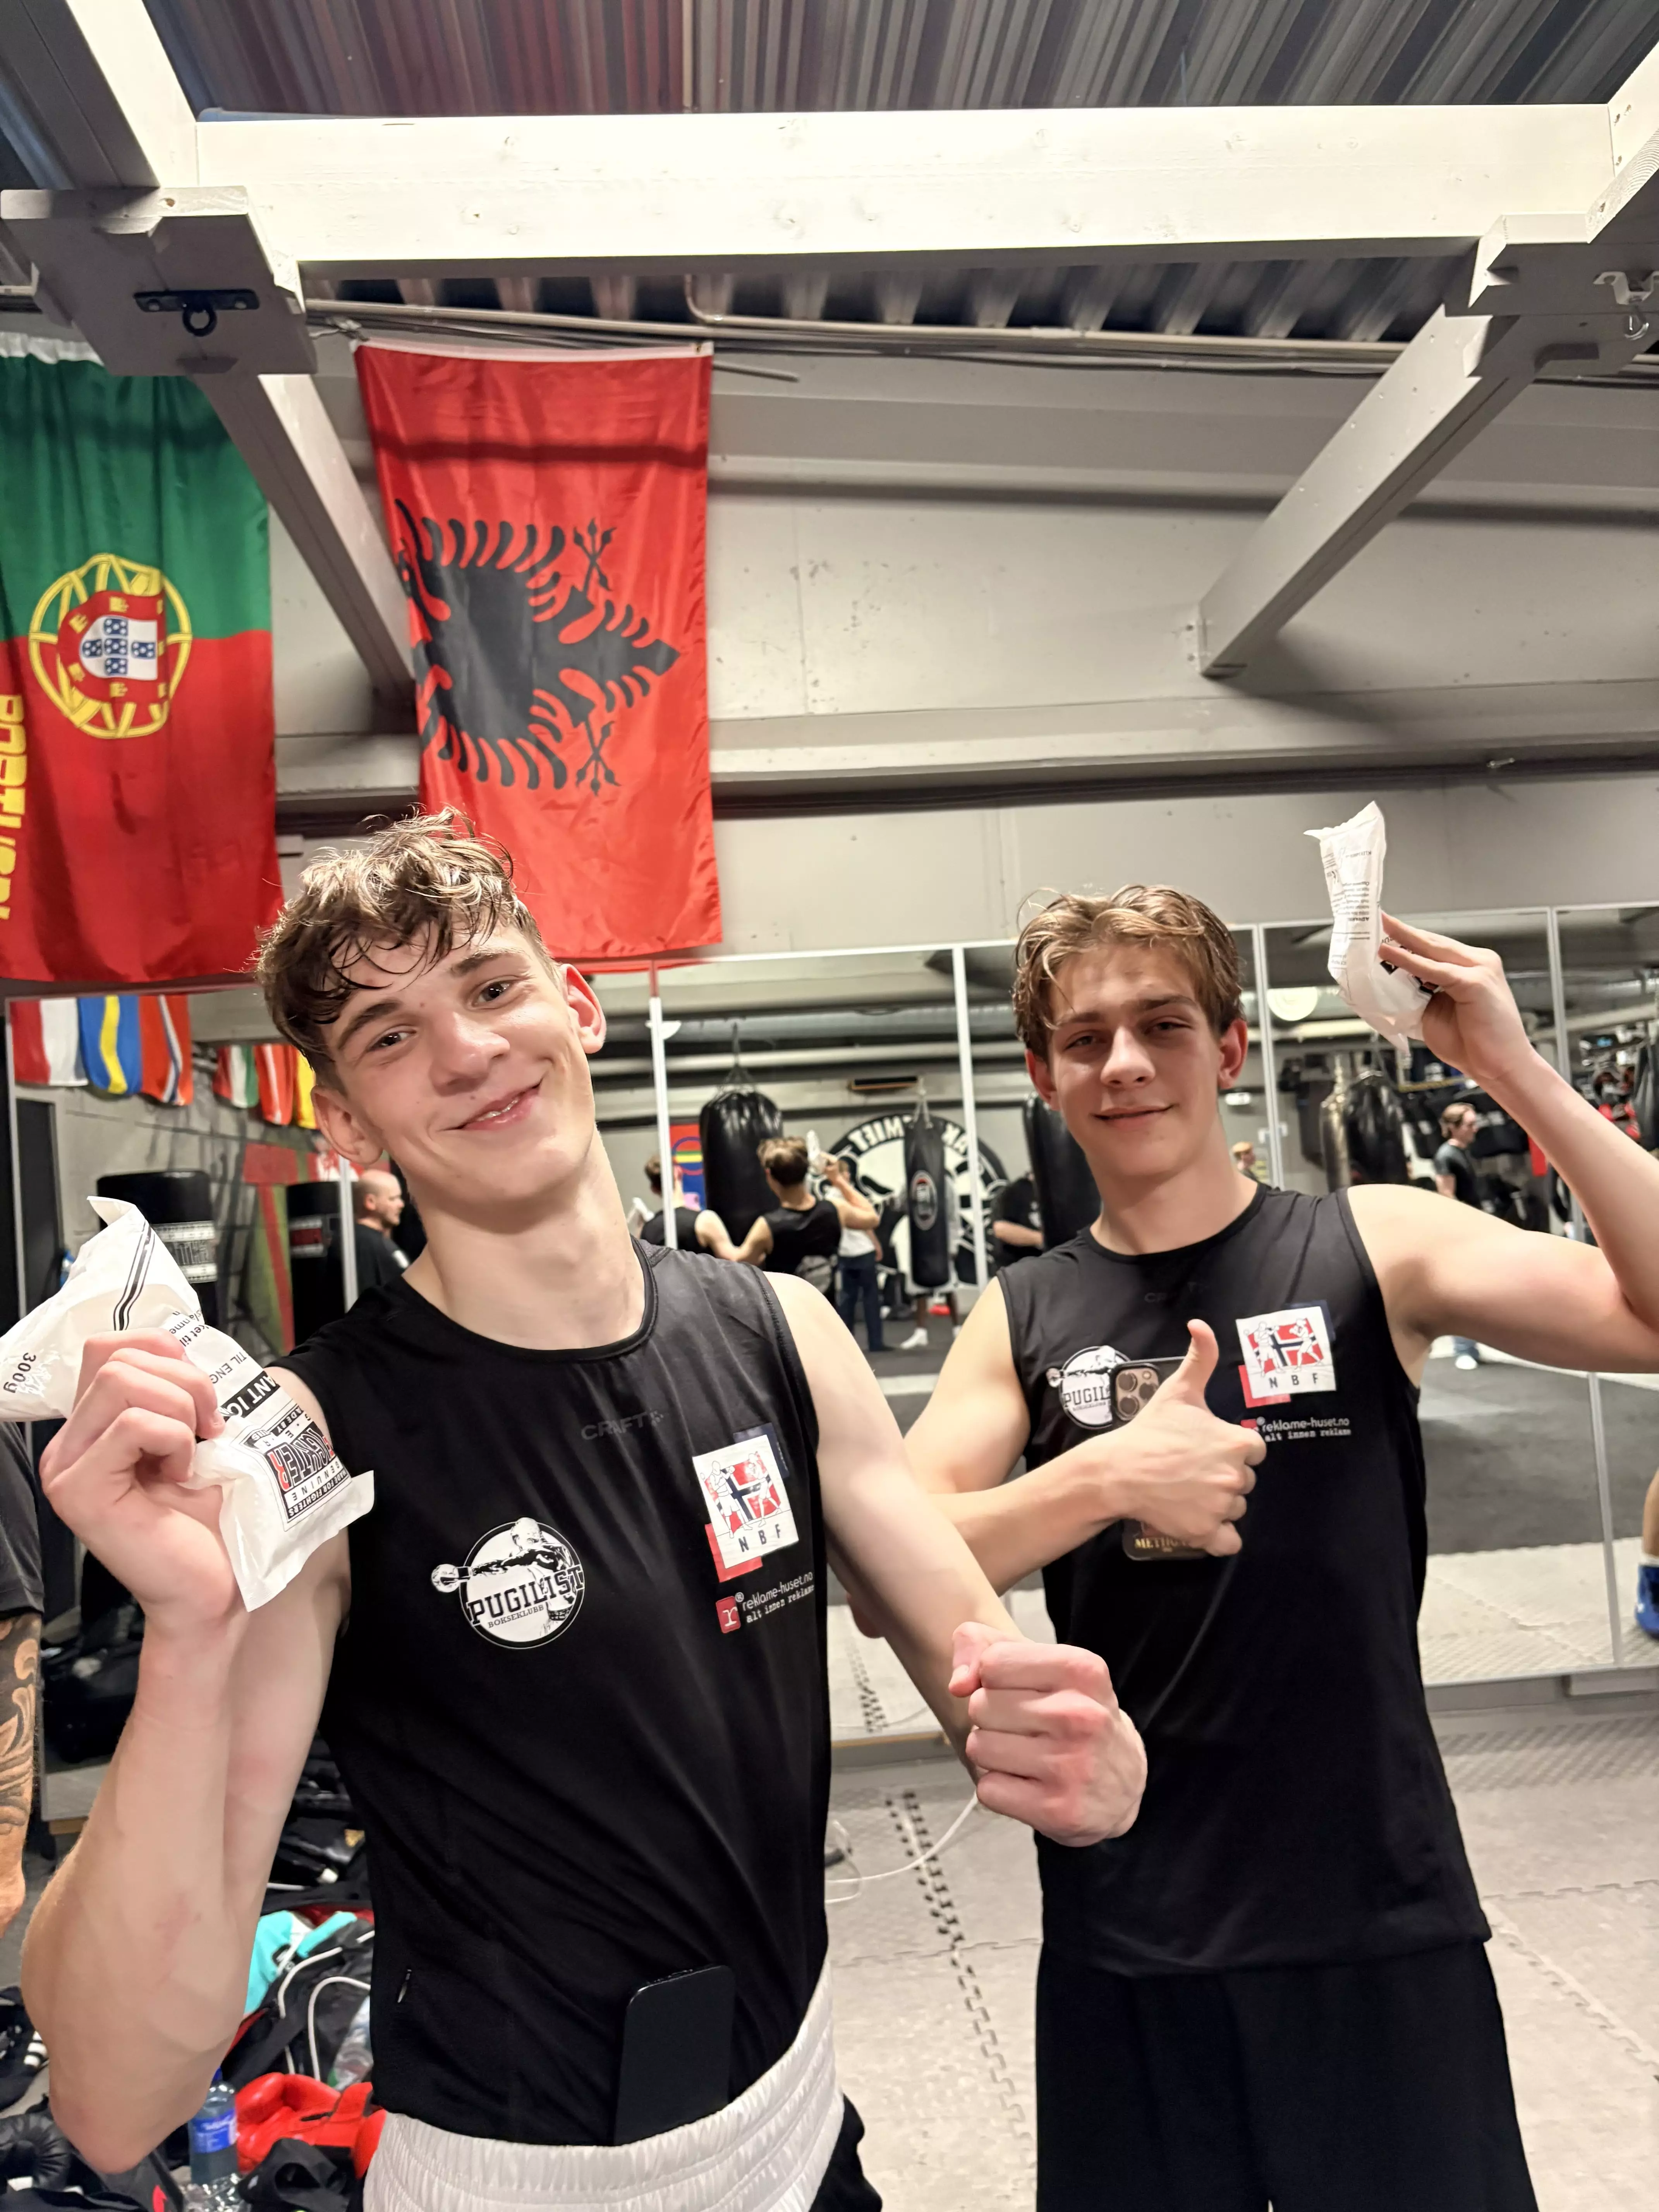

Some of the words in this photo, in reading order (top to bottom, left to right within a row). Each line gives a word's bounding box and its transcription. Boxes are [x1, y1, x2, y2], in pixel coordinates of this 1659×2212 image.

[230, 1352, 247, 1364] TIL
[3, 1352, 36, 1393] 300g
[209, 1363, 233, 1384] ENG
[581, 1412, 647, 1440] CRAFT
[1265, 1433, 1283, 1442] alt
[324, 1480, 334, 1492] FOR
[289, 1487, 323, 1516] FIGHTERS
[467, 1565, 584, 1625] PUGILIST
[742, 1571, 813, 1611] reklame-huset.no
[746, 1610, 762, 1623] alt
